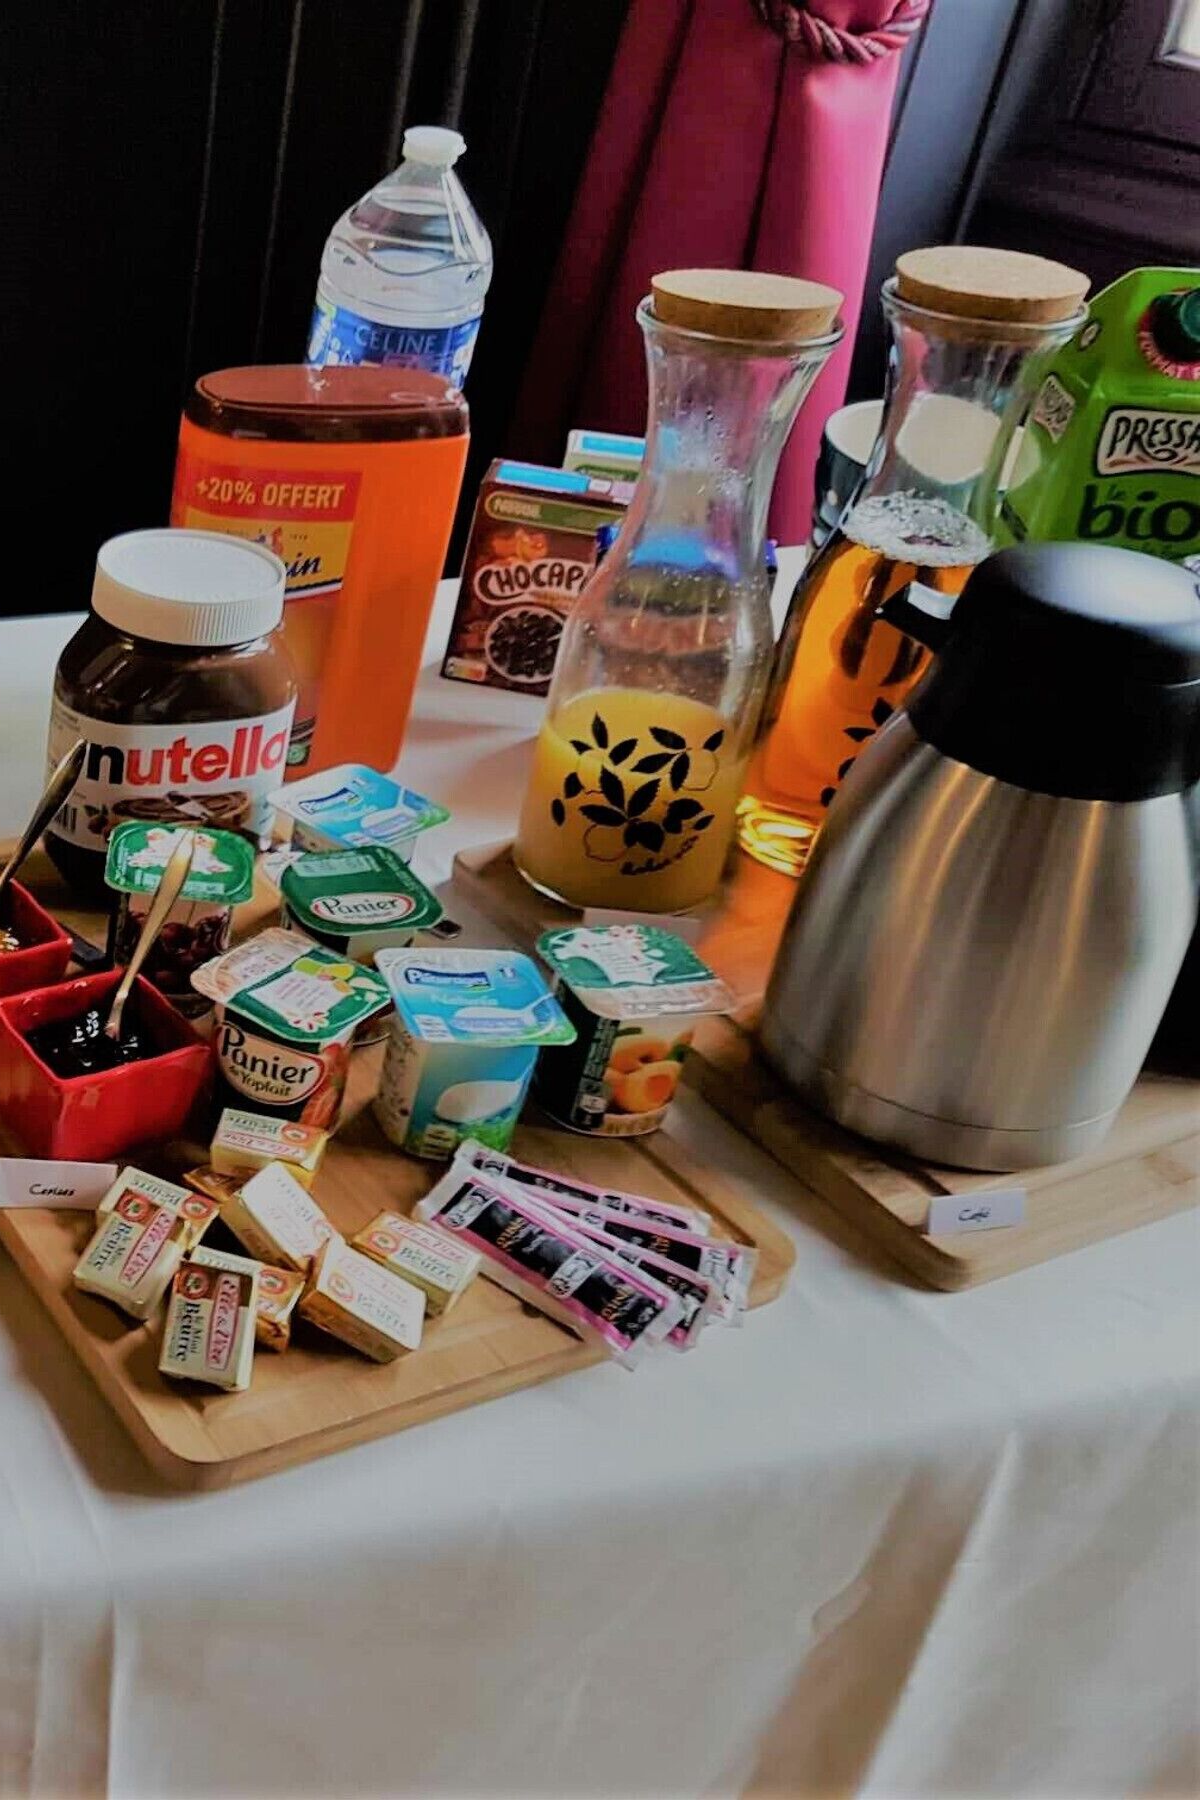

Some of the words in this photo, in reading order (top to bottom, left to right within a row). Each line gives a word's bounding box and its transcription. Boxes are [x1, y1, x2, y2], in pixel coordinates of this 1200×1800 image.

[197, 476, 256, 505] +20%
[262, 482, 346, 509] OFFERT
[1077, 483, 1200, 543] bio
[85, 724, 289, 787] nutella
[322, 896, 399, 916] Panier
[220, 1023, 316, 1085] Panier
[240, 1070, 292, 1098] Yoplait
[174, 1302, 201, 1363] Beurre
